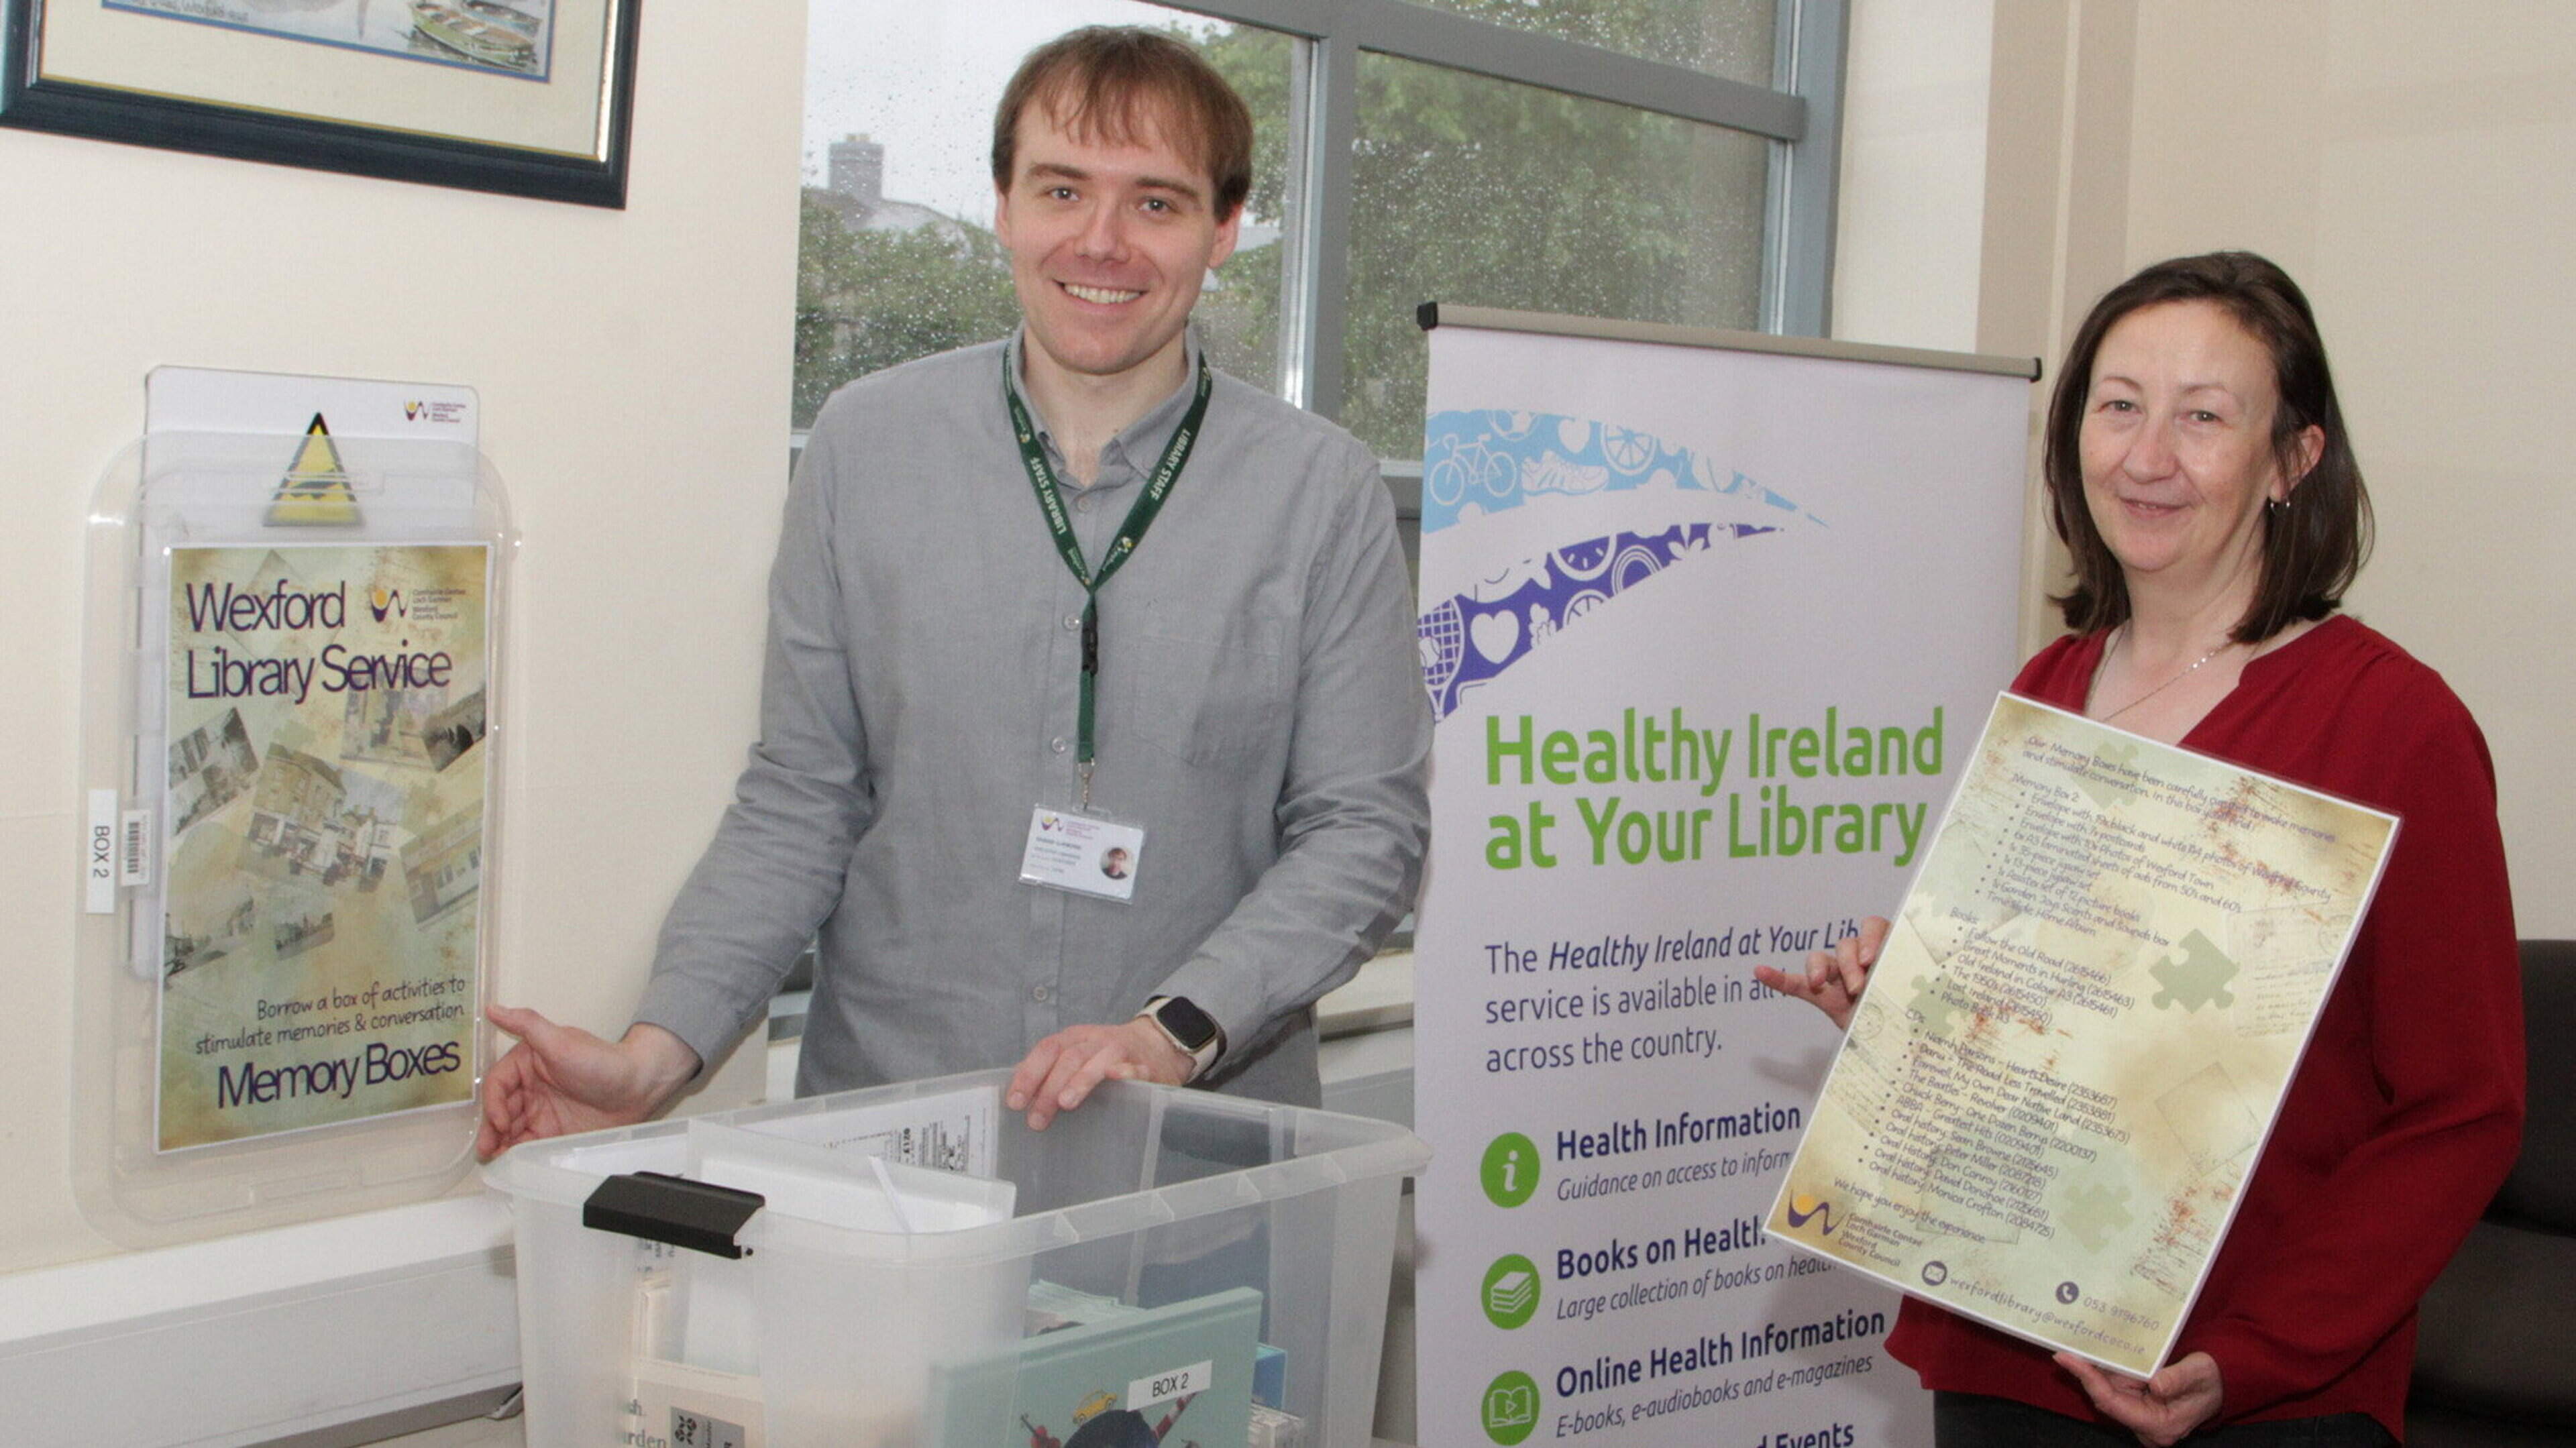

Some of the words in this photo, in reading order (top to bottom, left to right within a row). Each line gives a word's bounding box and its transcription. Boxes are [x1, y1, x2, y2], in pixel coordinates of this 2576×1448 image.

[1030, 456, 1049, 489] STAFF
[1165, 429, 1191, 472] LIBRARY
[1149, 467, 1173, 501] STAFF
[1042, 489, 1067, 535] LIBRARY
[186, 579, 346, 632] Wexford
[187, 646, 315, 704] Library
[321, 639, 452, 692] Service
[1486, 706, 1733, 797] Healthy
[1749, 706, 1943, 780] Ireland
[93, 825, 110, 862] BOX
[1485, 799, 1558, 870] at
[1575, 796, 1713, 866] Your
[1729, 784, 1927, 867] Library
[93, 869, 109, 879] 2
[1485, 942, 1538, 974] The
[1548, 934, 1650, 972] Healthy
[1654, 926, 1735, 964] Ireland
[1738, 928, 1762, 956] at
[1768, 925, 1819, 954] Your
[257, 998, 314, 1020] Borrow
[317, 997, 328, 1011] a
[332, 987, 358, 1009] box
[362, 981, 380, 1007] of
[382, 979, 445, 1000] activities
[449, 977, 465, 993] to
[1485, 988, 1584, 1024] service
[1592, 985, 1611, 1017] is
[1617, 978, 1717, 1016] available
[1723, 974, 1743, 1003] in
[195, 1029, 273, 1055] stimulate
[277, 1019, 350, 1044] memories
[355, 1013, 367, 1030] &
[371, 1003, 464, 1029] conversation
[1485, 1041, 1574, 1073] across
[1582, 1032, 1624, 1065] the
[1631, 1027, 1723, 1060] country.
[217, 1056, 360, 1109] Memory
[366, 1040, 461, 1085] Boxes
[1556, 1117, 1648, 1162] Health
[1655, 1103, 1801, 1150] Information
[1557, 1168, 1638, 1202] Guidance
[1642, 1170, 1662, 1192] on
[1665, 1160, 1717, 1186] access
[1721, 1156, 1739, 1178] to
[1556, 1243, 1639, 1281] Books
[1646, 1238, 1676, 1264] on
[1557, 1290, 1606, 1322] Large
[1609, 1276, 1689, 1315] collection
[1692, 1269, 1713, 1301] of
[1713, 1263, 1762, 1292] books
[1764, 1263, 1785, 1282] on
[1556, 1357, 1642, 1397] Online
[1650, 1337, 1733, 1379] Health
[1741, 1308, 1886, 1361] Information
[1152, 1376, 1179, 1398] BOX
[1181, 1373, 1189, 1389] 2
[1556, 1404, 1626, 1439] E-books,
[1631, 1376, 1741, 1422] e-audiobooks
[1744, 1372, 1774, 1398] and
[1776, 1351, 1873, 1395] e-magazines
